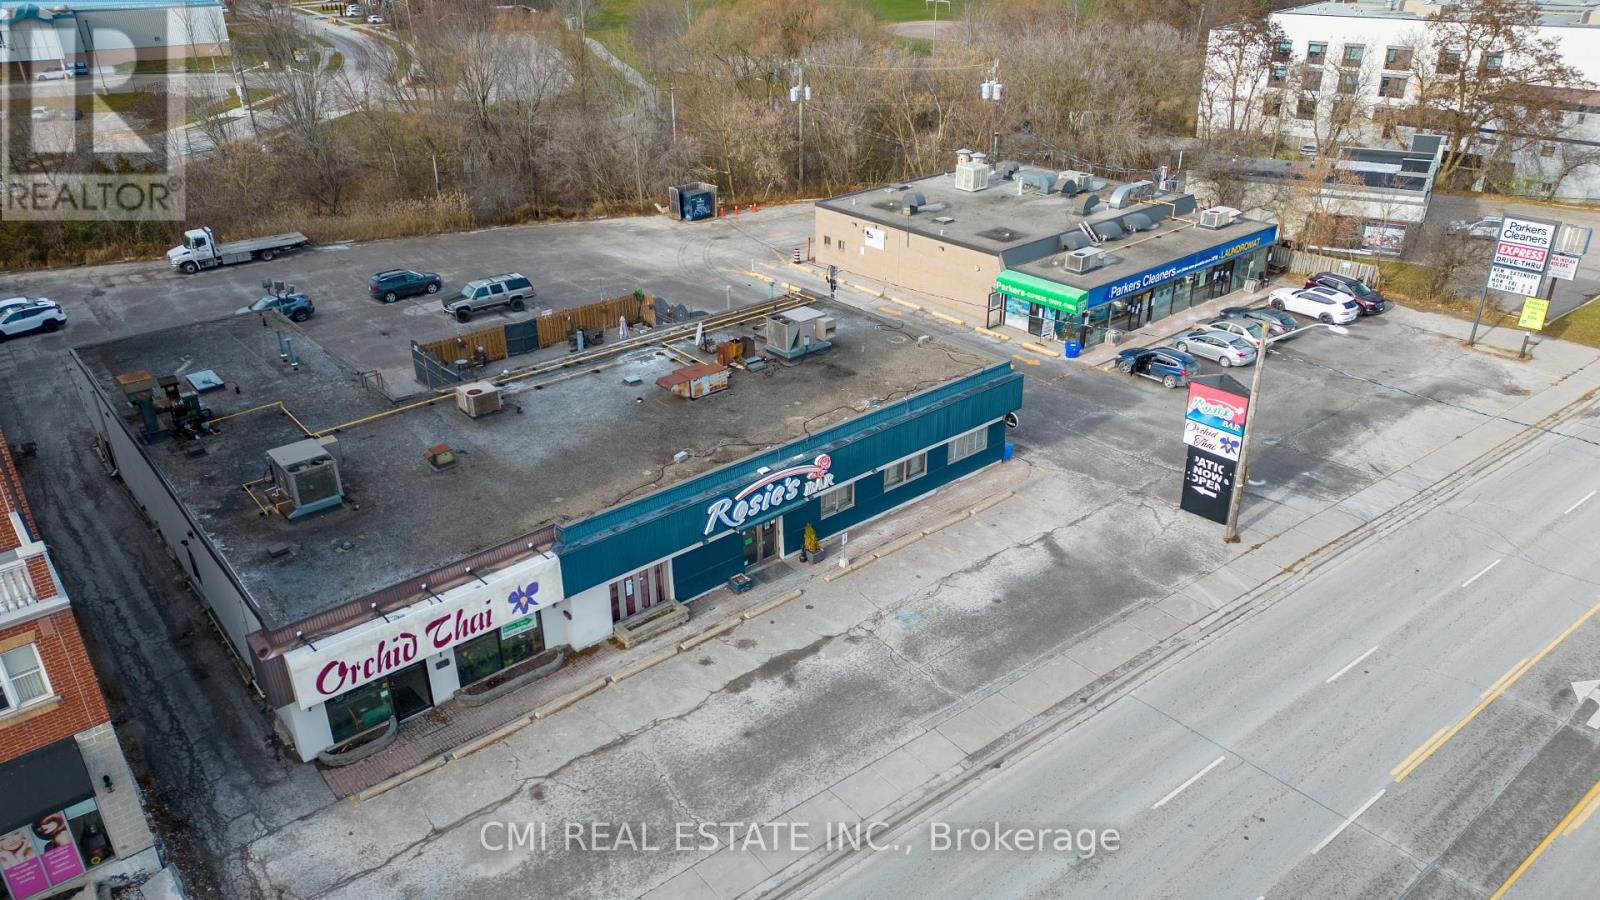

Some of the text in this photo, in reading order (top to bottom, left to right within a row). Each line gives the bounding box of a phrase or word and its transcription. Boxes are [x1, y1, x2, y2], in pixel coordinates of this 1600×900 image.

[1503, 229, 1548, 245] Cleaners
[1509, 221, 1548, 236] Parkers
[1220, 237, 1261, 258] LAUNDROMAT
[1499, 244, 1545, 261] EXPRESS
[1496, 256, 1542, 270] DRIVE-THRU
[996, 281, 1026, 298] Parkers
[1110, 266, 1177, 299] Parkers Cleaners
[1185, 422, 1219, 438] Orchid
[1222, 420, 1241, 432] BAR
[1193, 434, 1217, 451] Thai
[1192, 465, 1223, 484] NOW
[703, 472, 835, 536] Rosie's BAR
[315, 600, 492, 695] Orchid Thai
